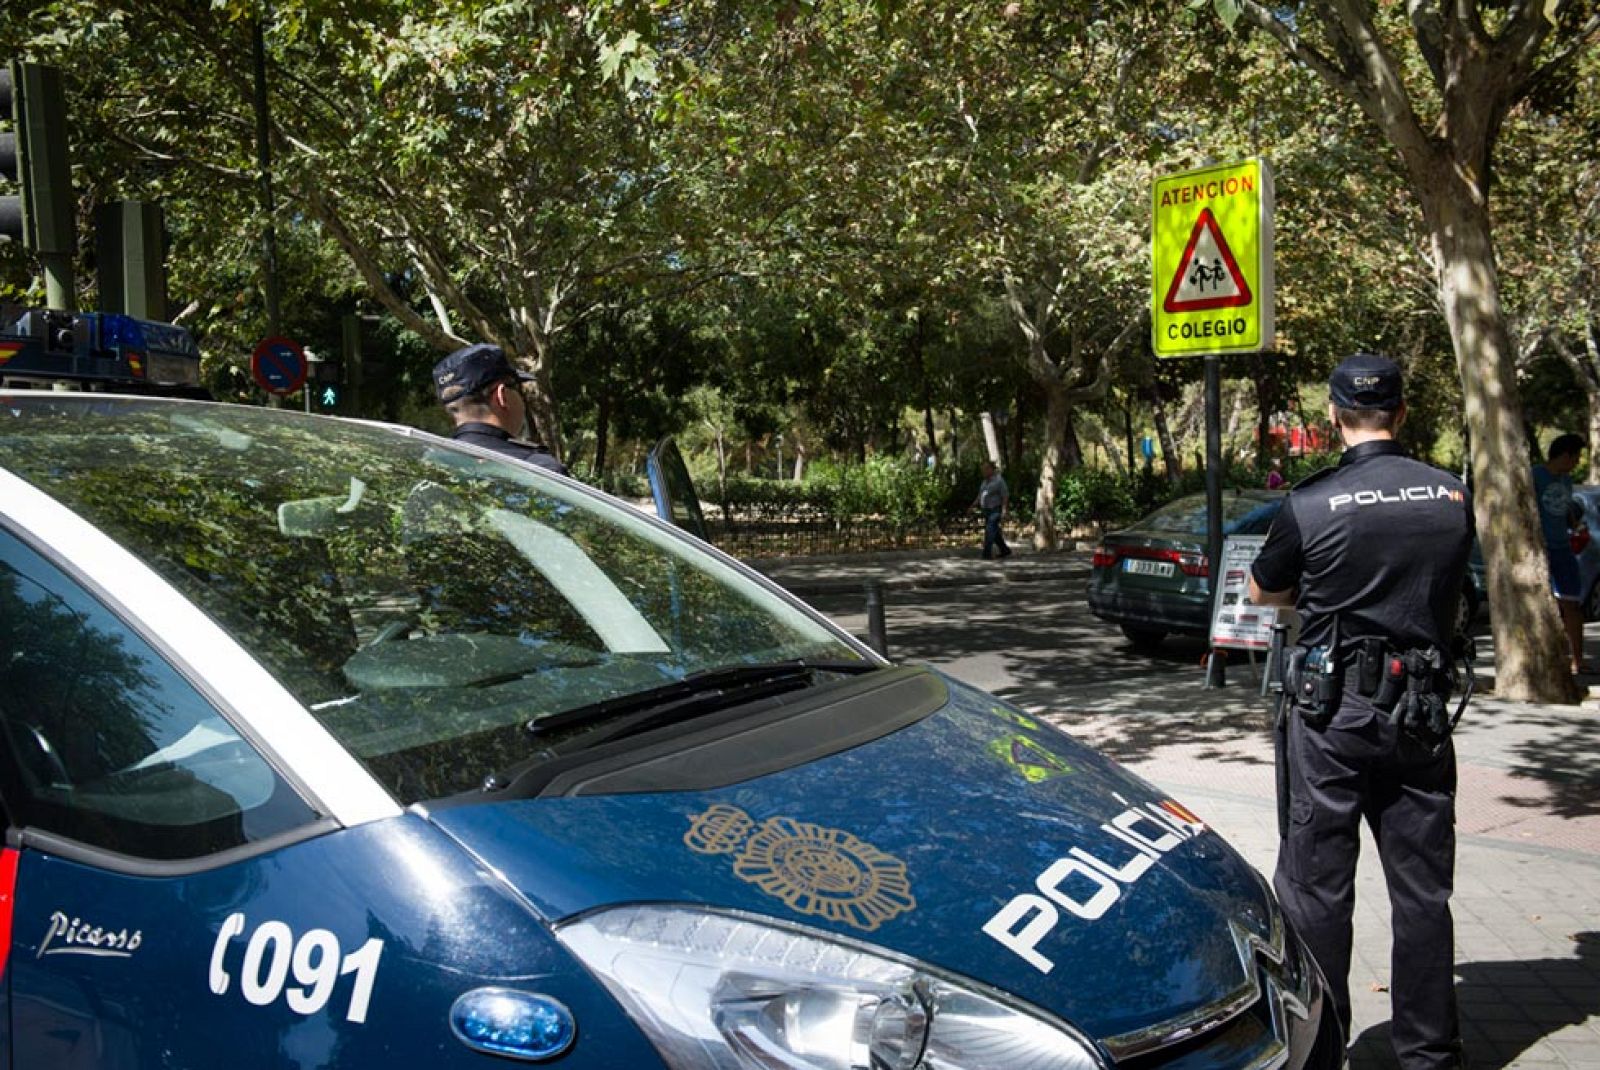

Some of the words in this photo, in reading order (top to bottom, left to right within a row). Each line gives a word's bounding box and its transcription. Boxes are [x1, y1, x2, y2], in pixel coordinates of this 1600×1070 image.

[1160, 174, 1254, 208] ATENCION
[1168, 317, 1247, 341] COLEGIO
[1353, 375, 1381, 386] CNP
[1328, 484, 1451, 511] POLICIA
[35, 910, 143, 960] Picasso
[240, 919, 385, 1024] 091
